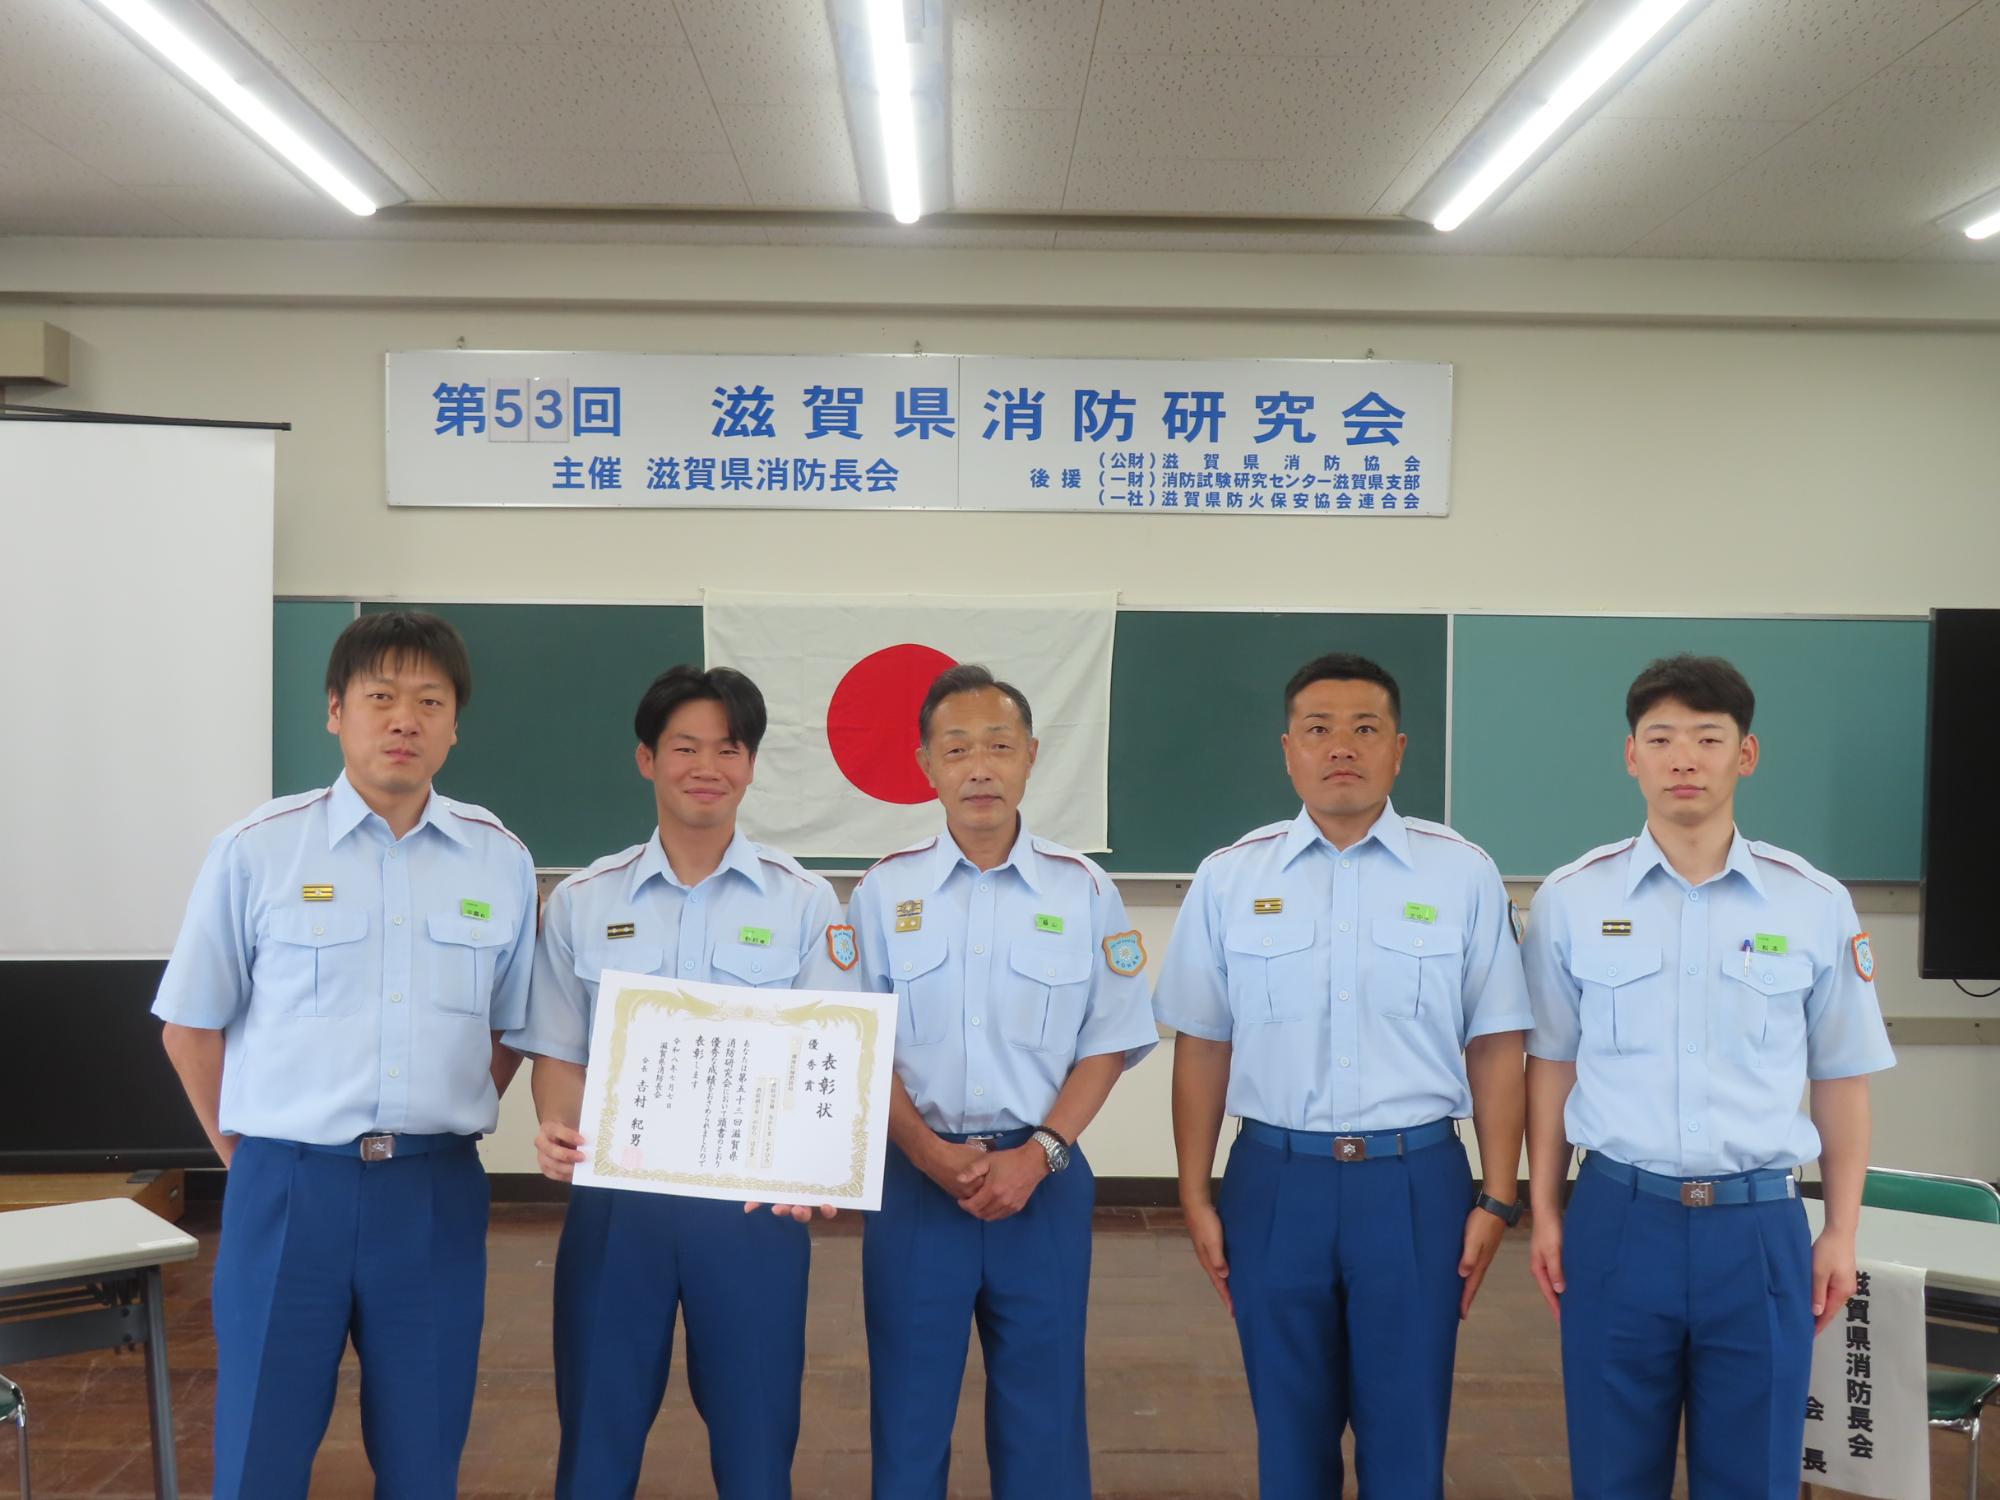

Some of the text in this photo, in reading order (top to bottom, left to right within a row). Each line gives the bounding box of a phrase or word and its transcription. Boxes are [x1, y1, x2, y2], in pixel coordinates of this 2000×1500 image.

[432, 382, 1406, 446] 第53回 滋賀県消防研究会
[552, 455, 900, 493] 主催 滋賀県消防長会
[1030, 467, 1082, 489] 後援
[691, 1034, 704, 1089] 表彰します
[804, 1038, 819, 1092] 優秀賞
[816, 1052, 837, 1119] 表彰状
